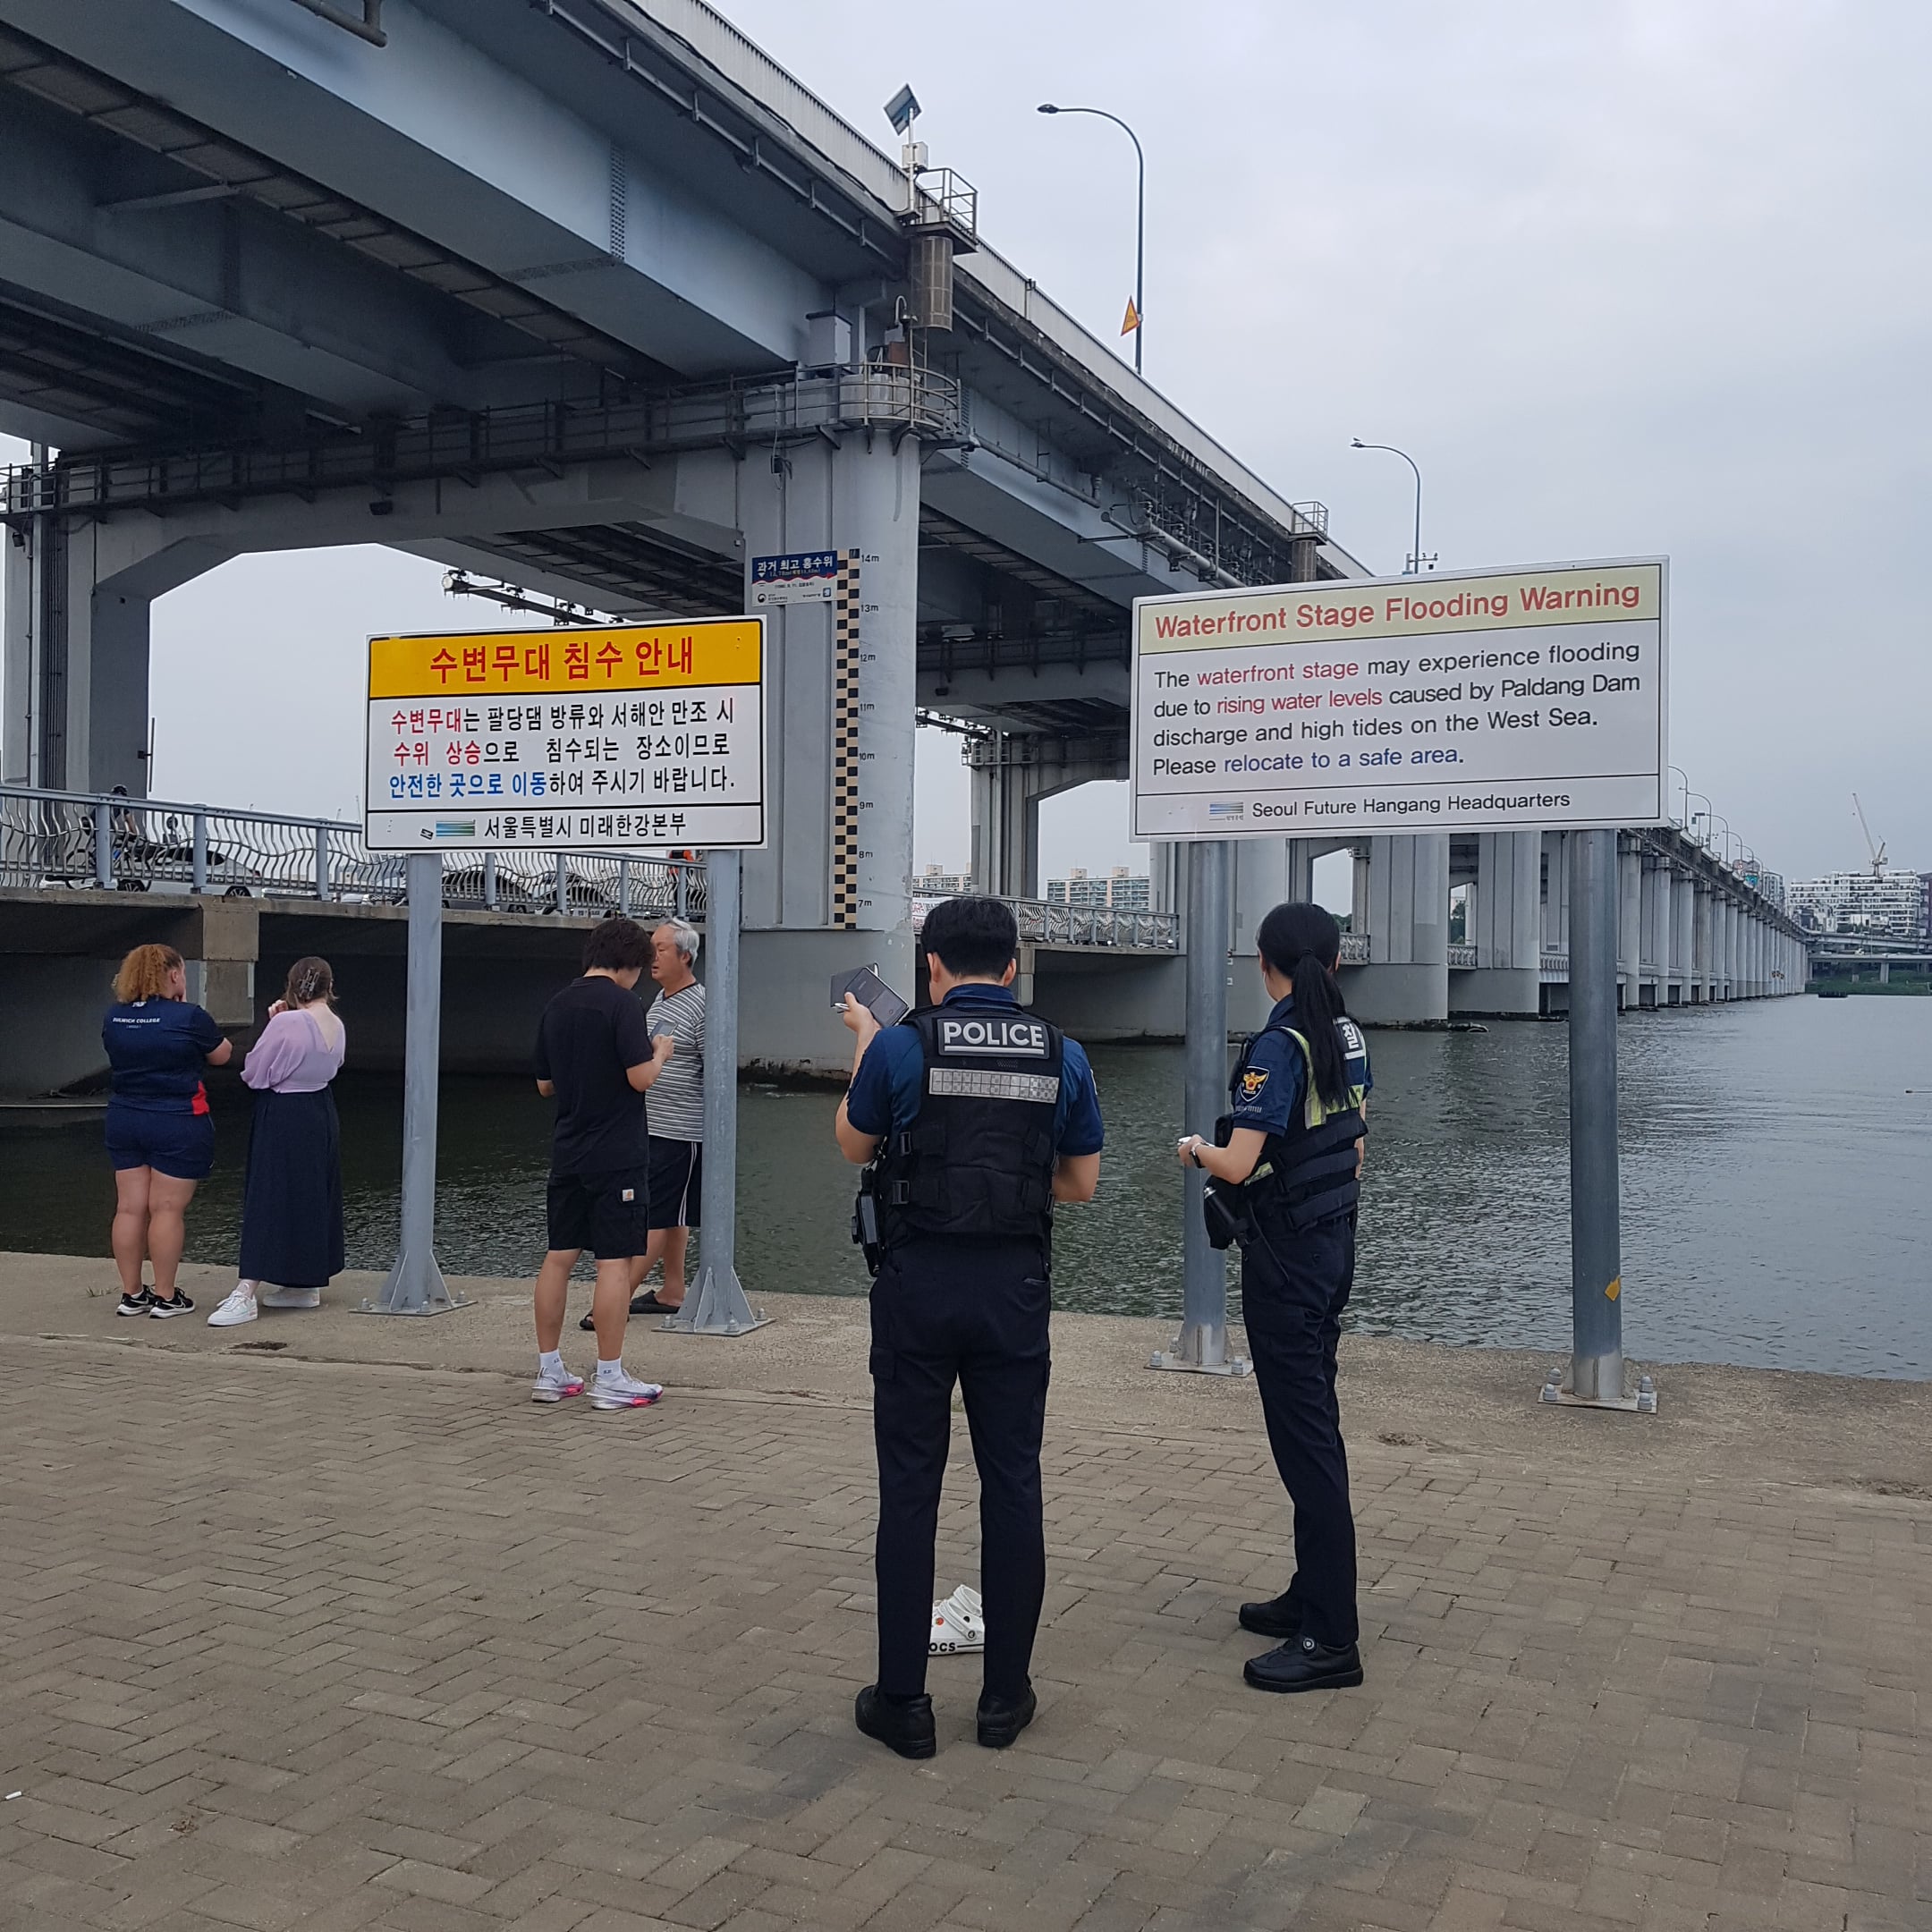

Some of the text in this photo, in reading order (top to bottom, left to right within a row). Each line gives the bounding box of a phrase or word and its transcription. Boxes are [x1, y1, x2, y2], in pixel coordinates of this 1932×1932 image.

[861, 554, 879, 563] 14m
[860, 604, 879, 613] 13m
[1156, 583, 1639, 638] Waterfront Stage Flooding Warning
[431, 637, 691, 683] 수변무대 침수 안내
[860, 654, 876, 663] 12m
[1155, 642, 1639, 688] The waterfront stage may experience flooding
[860, 703, 875, 712] 11m
[1155, 674, 1640, 717] due to rising water levels caused by Paldang Dam
[392, 698, 733, 734] 수변무대는 팔당댐 방류와 서해안 만조 시
[1154, 708, 1597, 746] discharge and high tides on the West Sea.
[394, 733, 729, 766] 수위 상승으로 침수되는 장소이므로
[859, 752, 875, 761] 10m
[1154, 749, 1463, 775] Please relocate to a safe area.
[390, 766, 733, 798] 안전한 곳으로 이동하여 주시기 바랍니다.
[859, 801, 874, 809] 9m
[1253, 793, 1570, 817] Seoul Future Hangang Headquarters
[485, 813, 685, 839] 서울특별시 미래한강본부
[859, 851, 873, 859] 8m
[858, 899, 872, 908] 7m
[944, 1022, 1045, 1046] POLICE
[1342, 1022, 1360, 1049] 찰
[929, 1642, 955, 1652] ocs
